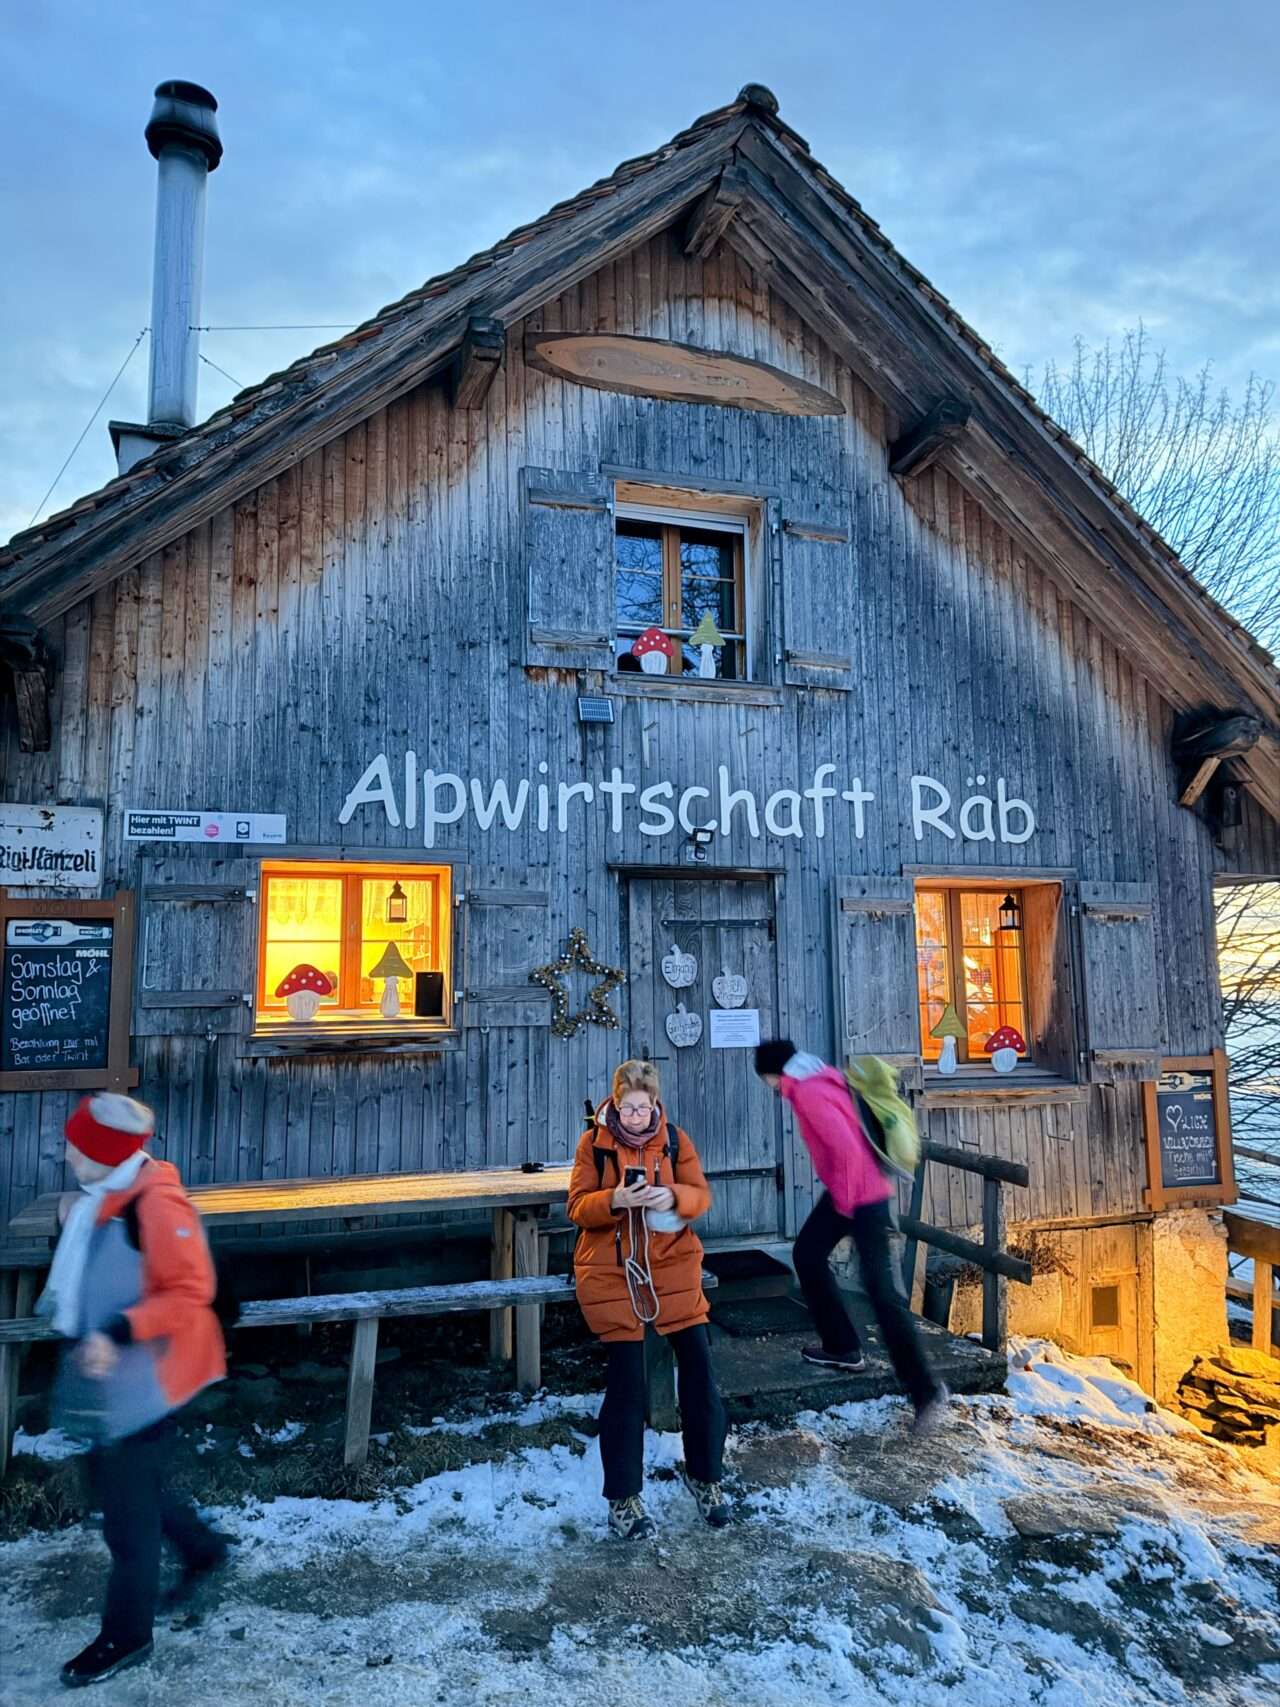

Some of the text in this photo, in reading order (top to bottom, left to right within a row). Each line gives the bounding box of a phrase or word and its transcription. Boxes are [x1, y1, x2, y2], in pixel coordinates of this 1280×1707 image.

[338, 750, 1036, 849] Alpwirtschaft Räb
[130, 815, 199, 826] Hier mit TWINT
[130, 825, 174, 836] bezahlen!
[75, 948, 110, 958] MÖHL
[11, 953, 102, 985] Samstag &
[10, 979, 82, 1004] Sonntag
[12, 1002, 77, 1030] geöffnet
